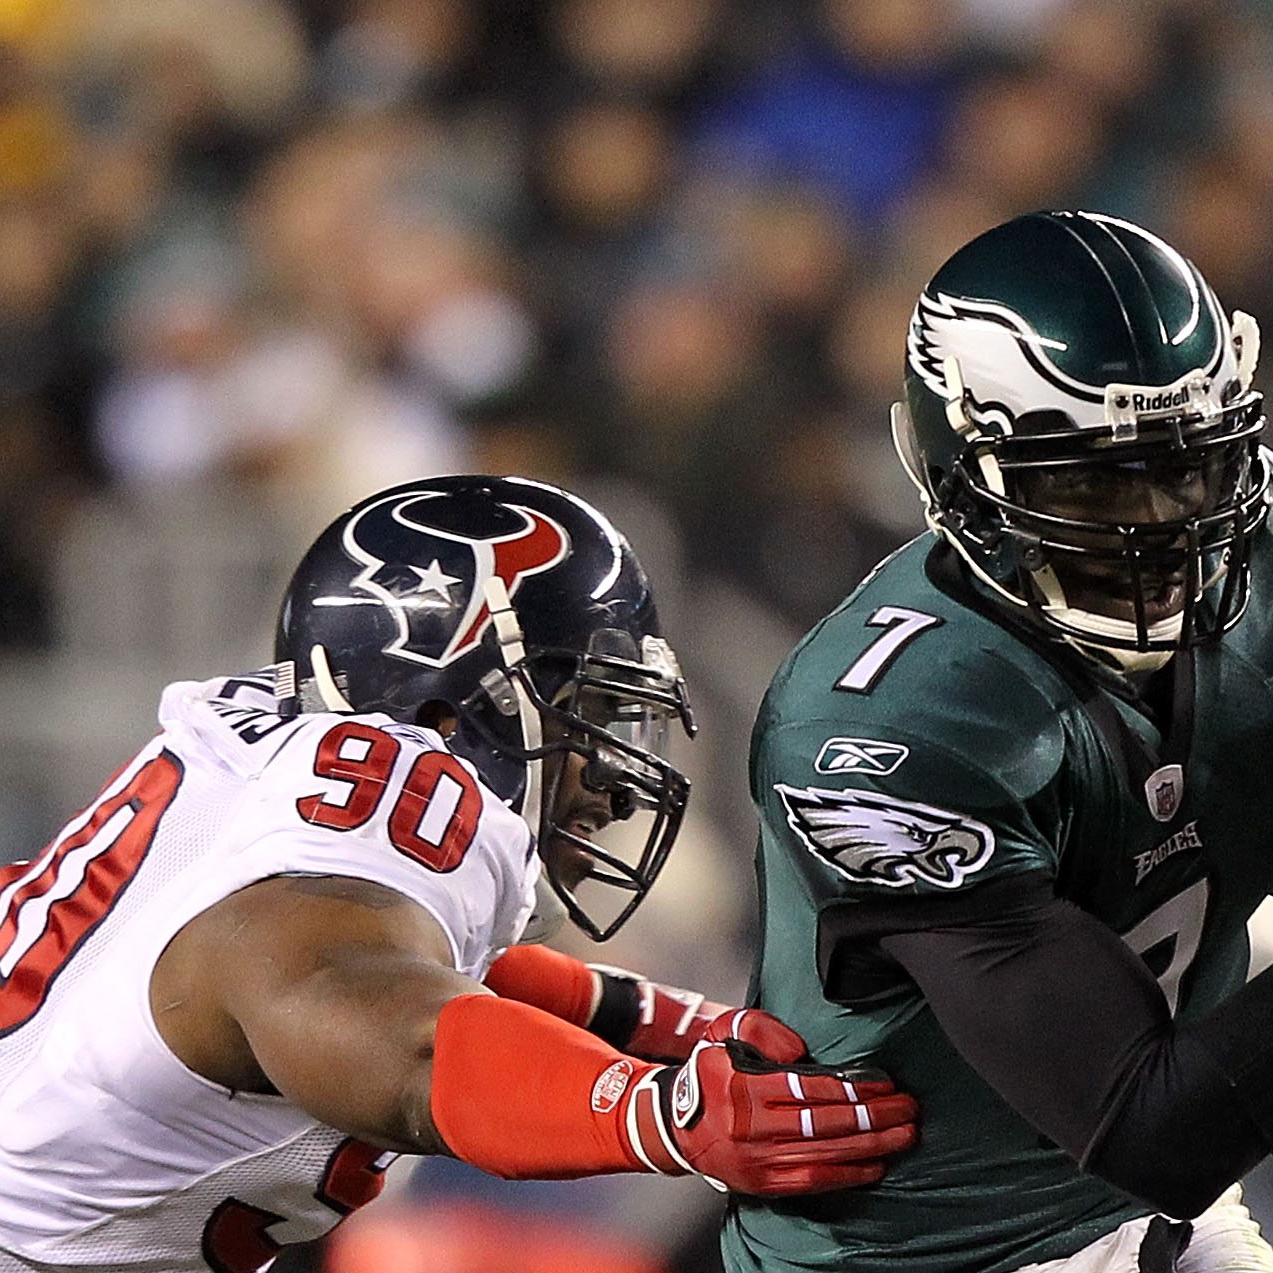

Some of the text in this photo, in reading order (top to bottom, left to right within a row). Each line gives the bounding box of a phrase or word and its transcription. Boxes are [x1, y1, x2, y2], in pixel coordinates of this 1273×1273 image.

[1132, 385, 1190, 411] Riddell
[831, 605, 944, 695] 7
[296, 721, 484, 873] 90
[1133, 820, 1203, 887] EAGLES
